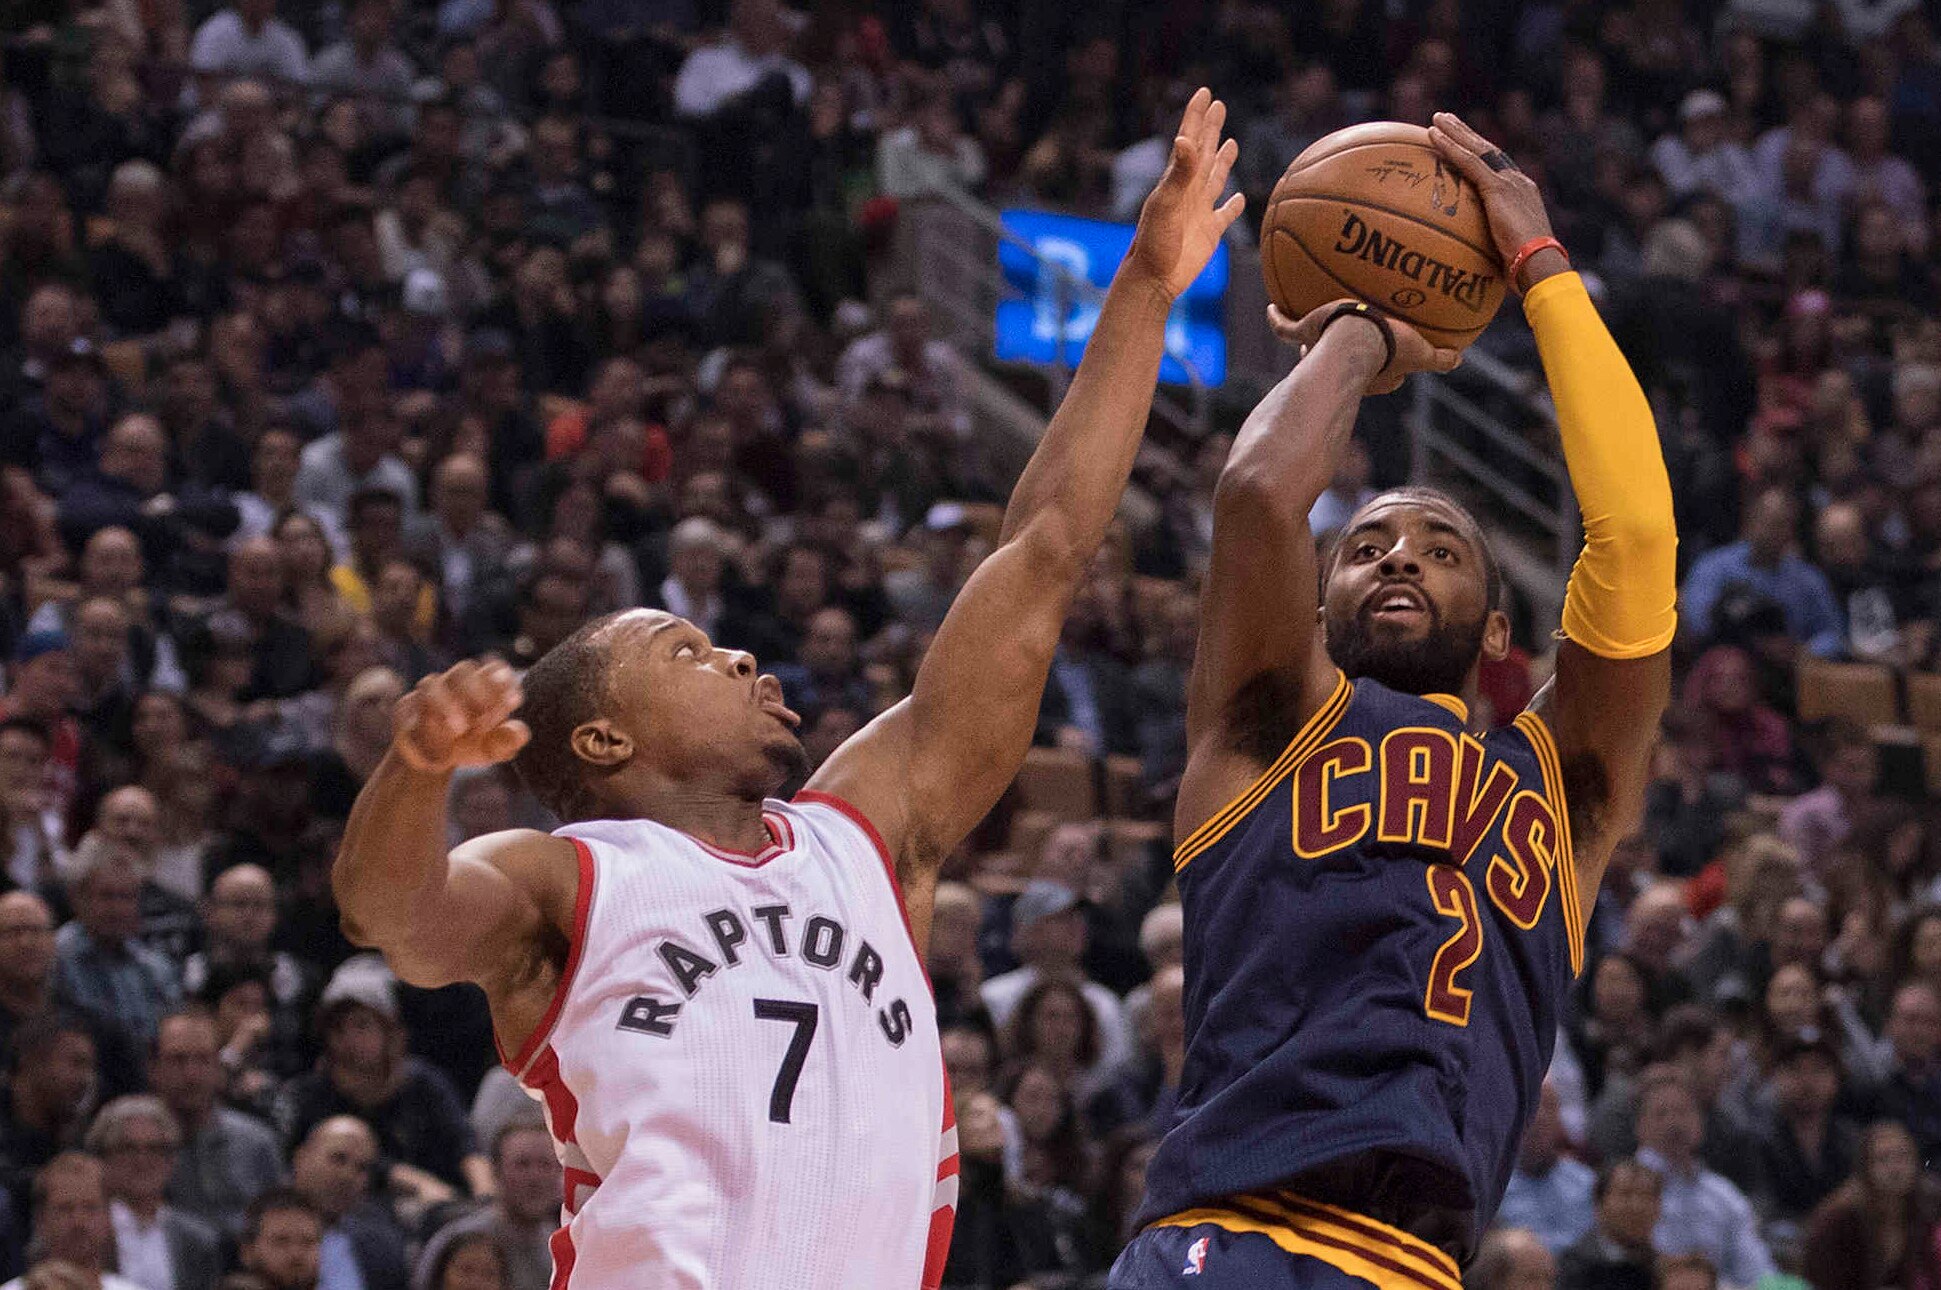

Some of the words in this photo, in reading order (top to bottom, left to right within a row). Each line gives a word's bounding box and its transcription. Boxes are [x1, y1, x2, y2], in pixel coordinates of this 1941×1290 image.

[1335, 211, 1494, 312] SPALDING
[1292, 726, 1558, 930] CAVS
[615, 903, 913, 1049] RAPTORS
[1424, 863, 1484, 1027] 2
[753, 998, 819, 1125] 7
